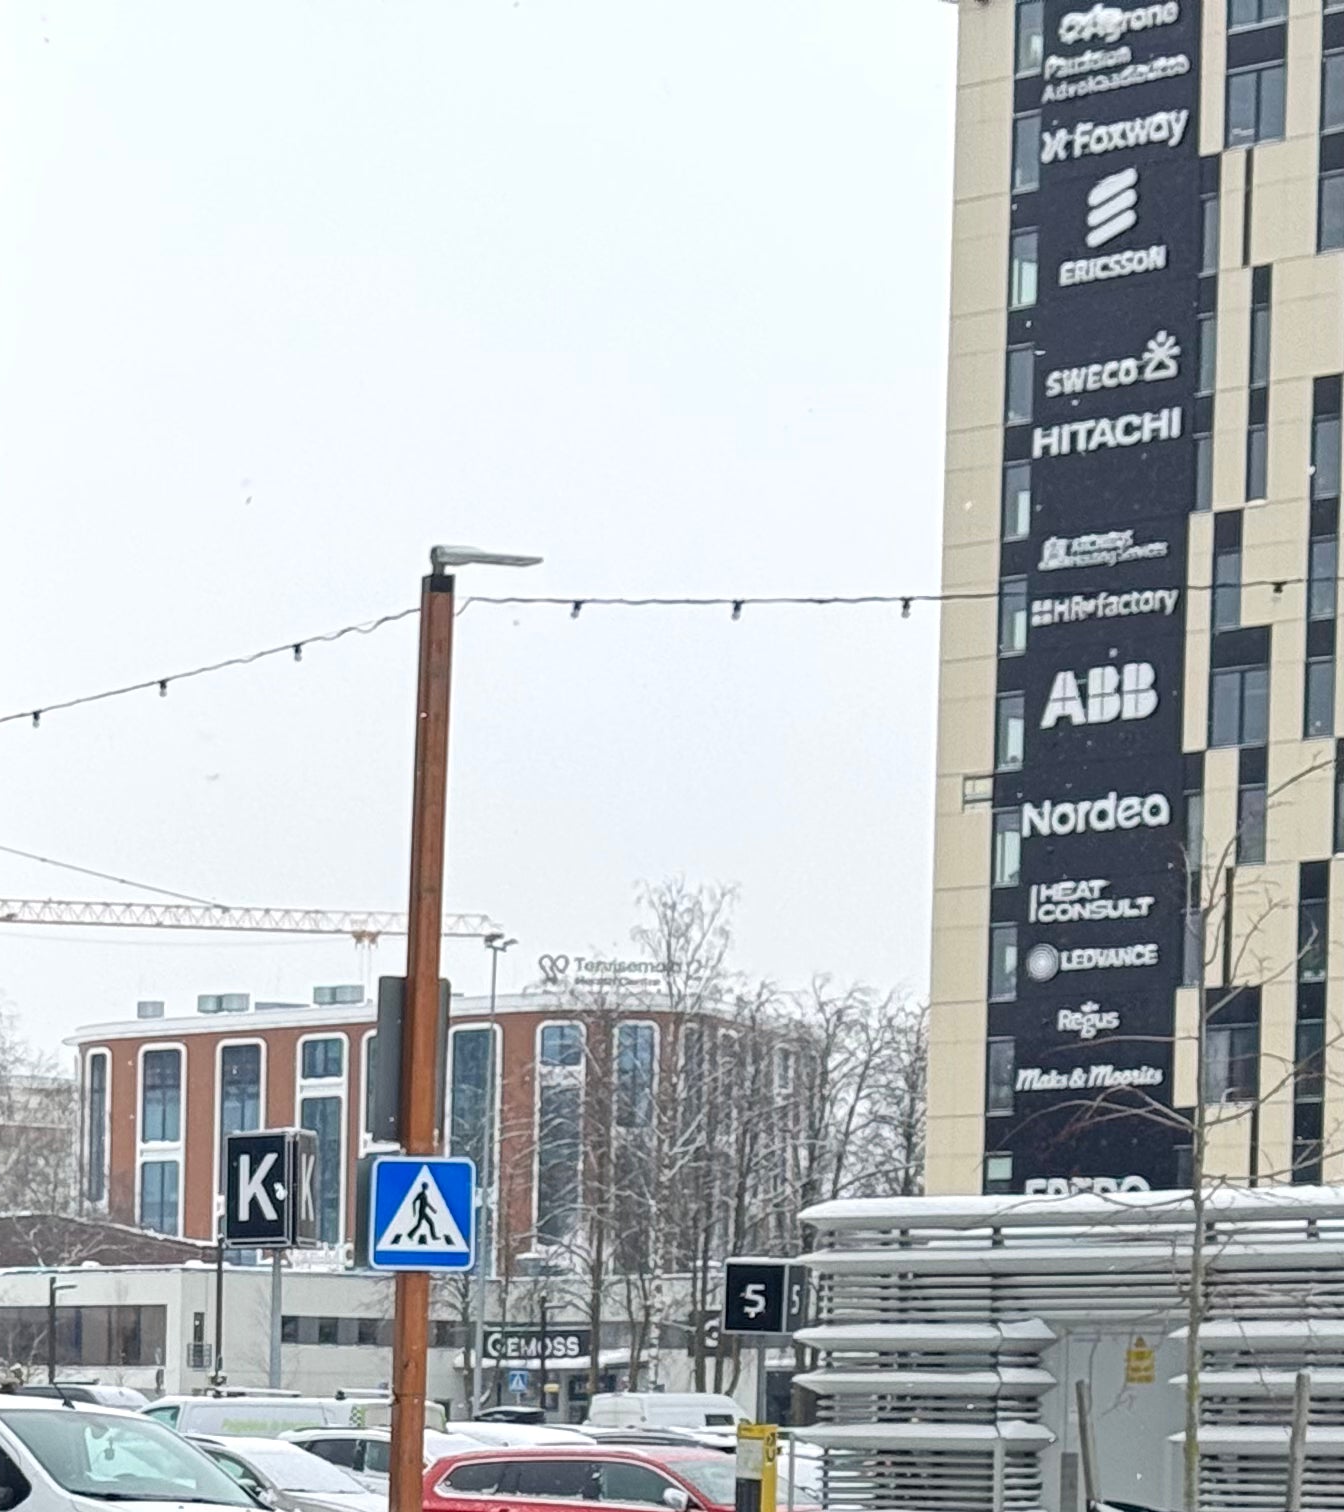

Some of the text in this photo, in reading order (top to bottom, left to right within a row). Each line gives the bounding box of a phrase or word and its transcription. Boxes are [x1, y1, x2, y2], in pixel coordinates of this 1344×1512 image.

[1074, 109, 1189, 158] Foxway
[1059, 245, 1167, 286] ERICSSON
[1045, 357, 1138, 397] SWECO
[1032, 407, 1182, 458] HITACHI
[1040, 662, 1159, 729] ABB
[1022, 792, 1170, 838] Nordea
[1038, 897, 1155, 922] CONSULT
[1039, 879, 1110, 901] HEAT
[1061, 944, 1159, 971] LEDVANCE
[1057, 1009, 1120, 1038] Regus
[238, 1153, 279, 1221] K
[301, 1153, 315, 1221] K
[743, 1283, 766, 1314] 5
[487, 1333, 581, 1357] GEMOSS
